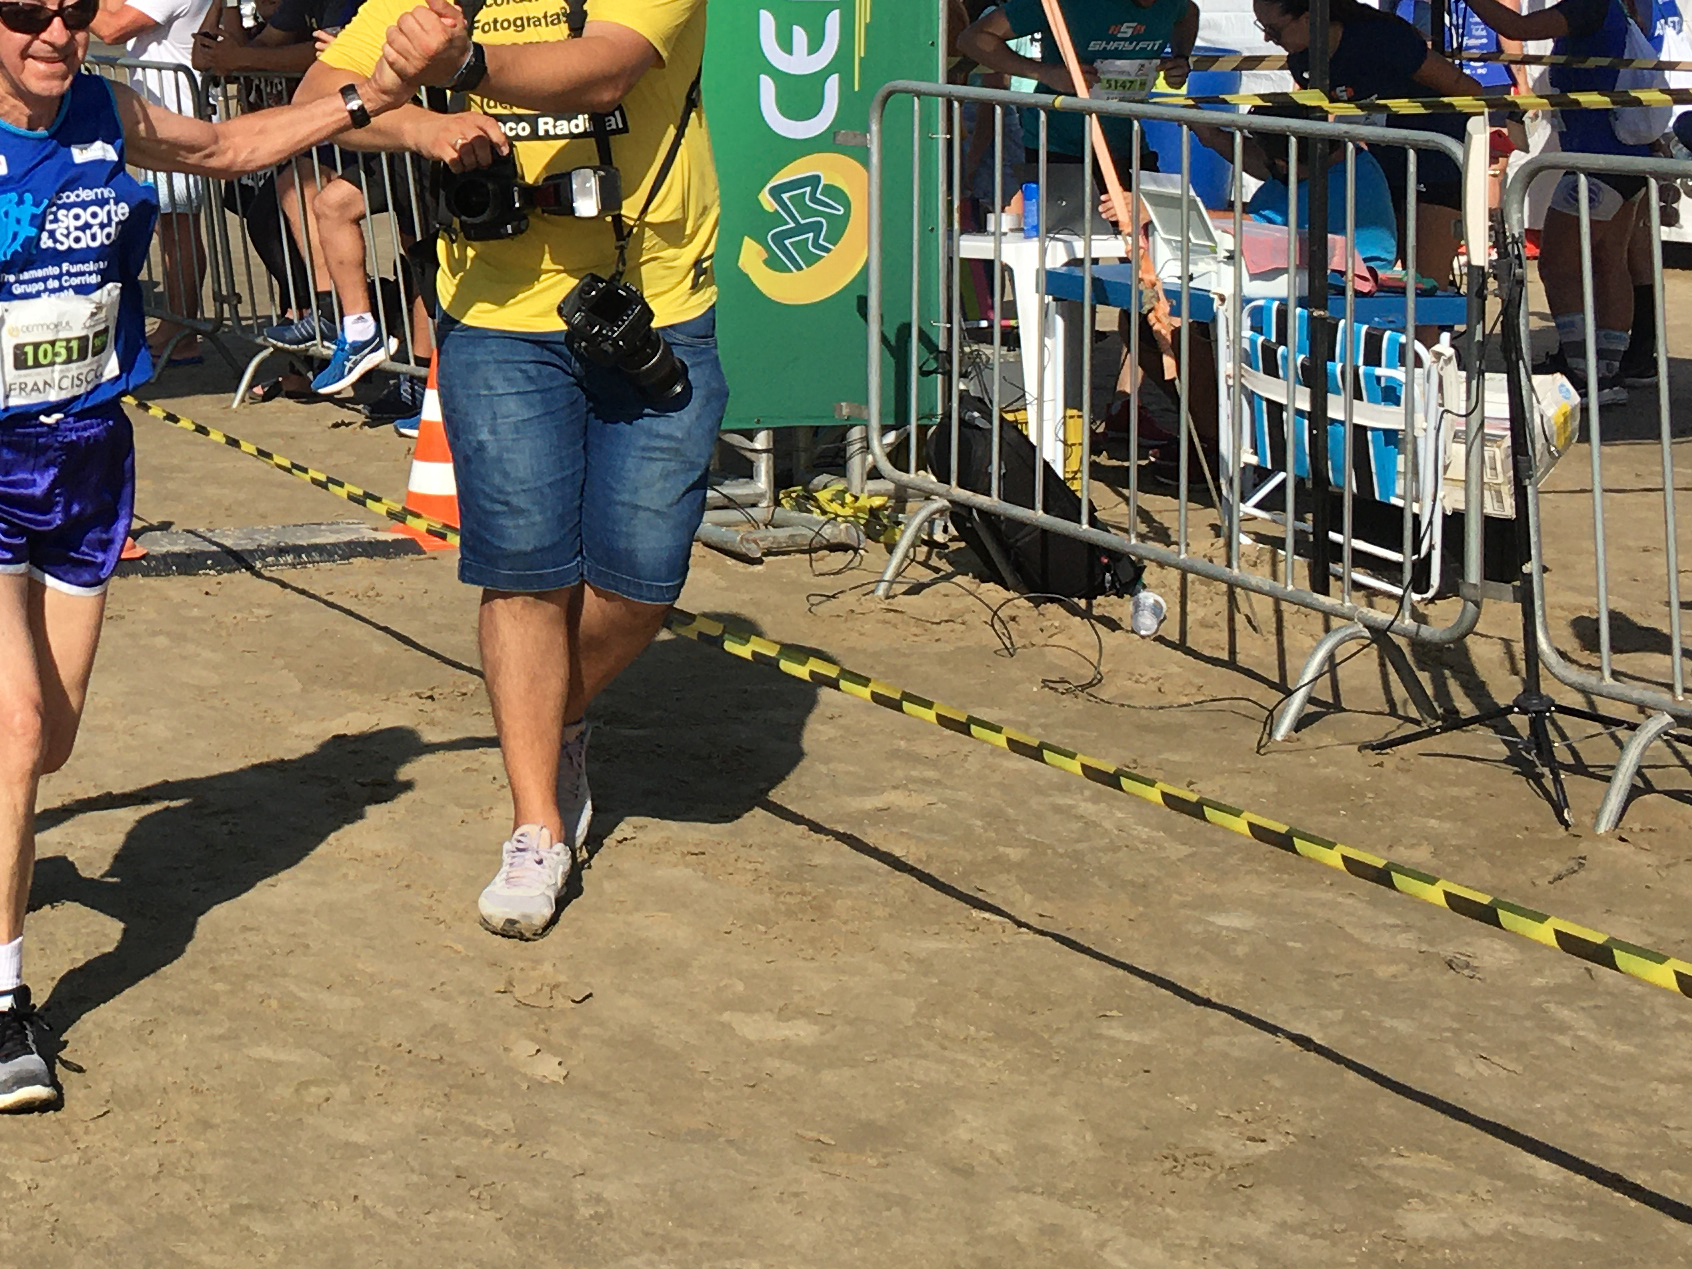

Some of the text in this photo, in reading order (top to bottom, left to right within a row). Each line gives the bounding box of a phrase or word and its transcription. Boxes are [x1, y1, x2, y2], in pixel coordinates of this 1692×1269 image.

[537, 110, 624, 136] Radial
[45, 199, 129, 232] Esporte
[11, 282, 45, 295] Grupo
[46, 275, 59, 289] de
[23, 339, 79, 366] 1051
